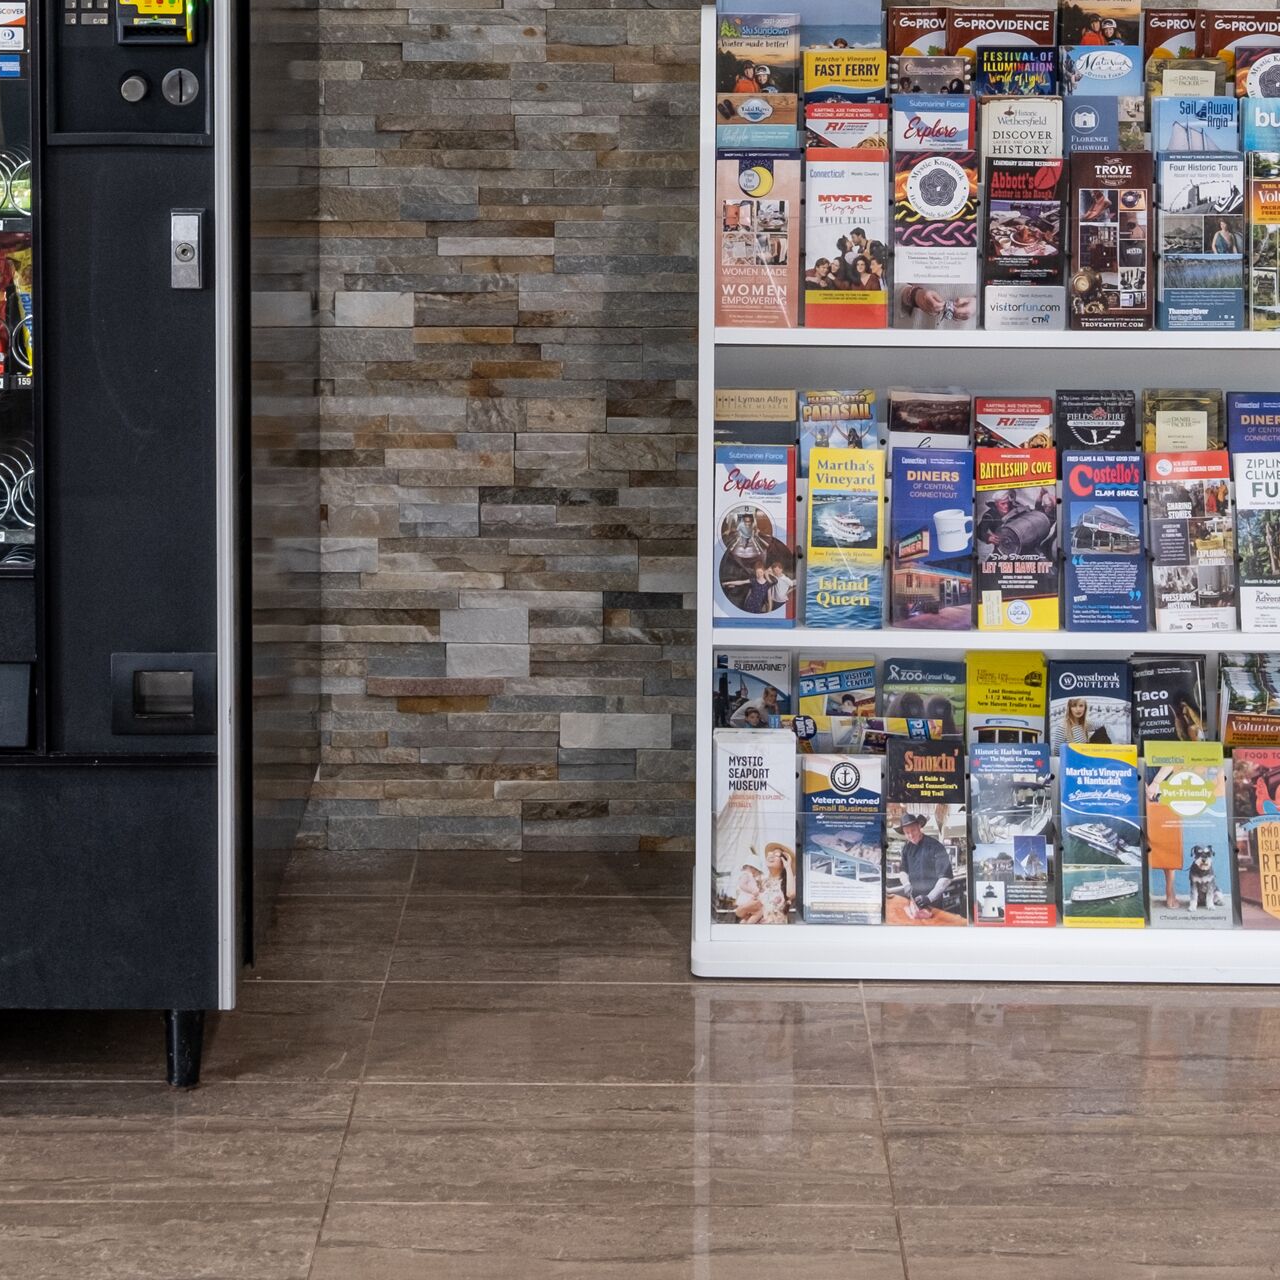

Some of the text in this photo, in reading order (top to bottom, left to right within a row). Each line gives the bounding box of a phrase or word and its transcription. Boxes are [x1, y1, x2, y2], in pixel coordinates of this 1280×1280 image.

[983, 52, 1054, 61] FESTIVAL OF
[814, 64, 880, 76] FAST FERRY
[983, 62, 1053, 72] ILLUMINATION
[989, 72, 1012, 83] World
[1180, 101, 1233, 120] Sail Away
[997, 116, 1047, 126] Wethersfield
[1207, 116, 1228, 129] Argia
[904, 116, 958, 144] Explore
[992, 131, 1052, 140] DISCOVER
[1095, 165, 1132, 175] TROVE
[991, 172, 1034, 189] Abbott's
[822, 203, 872, 215] Pizza
[762, 269, 787, 277] MADE
[722, 285, 787, 295] WOMEN
[722, 296, 787, 304] EMPOWERING
[990, 303, 1060, 311] visitorfun.com
[803, 404, 873, 420] PARASAIL
[818, 460, 874, 471] Martha's
[980, 462, 1052, 479] BATTLESHIP COVE
[816, 473, 875, 487] Vineyard
[907, 471, 959, 481] DINERS
[1069, 464, 1139, 496] Costello's
[723, 468, 776, 497] Explore
[1167, 502, 1192, 510] SHARING
[1168, 511, 1192, 519] STORIES
[820, 577, 868, 591] Island
[816, 592, 869, 608] Queen
[734, 663, 786, 671] SUBMARINE?
[844, 671, 872, 679] VISITOR
[1077, 672, 1120, 682] westbrook
[802, 675, 841, 694] PEZ
[847, 678, 872, 686] CENTER
[1077, 681, 1120, 689] OUTLETS
[1001, 688, 1031, 696] Remaining
[1134, 689, 1169, 701] Taco
[1136, 705, 1169, 718] Trail
[729, 756, 763, 766] MYSTIC
[905, 749, 958, 772] Smokin'
[729, 769, 770, 779] SEAPORT
[1066, 768, 1132, 777] Martha's Vineyard
[729, 781, 767, 791] MUSEUM
[1077, 777, 1121, 785] & Nantucket
[1163, 788, 1212, 798] Pet-Friendly
[849, 797, 879, 805] Owned
